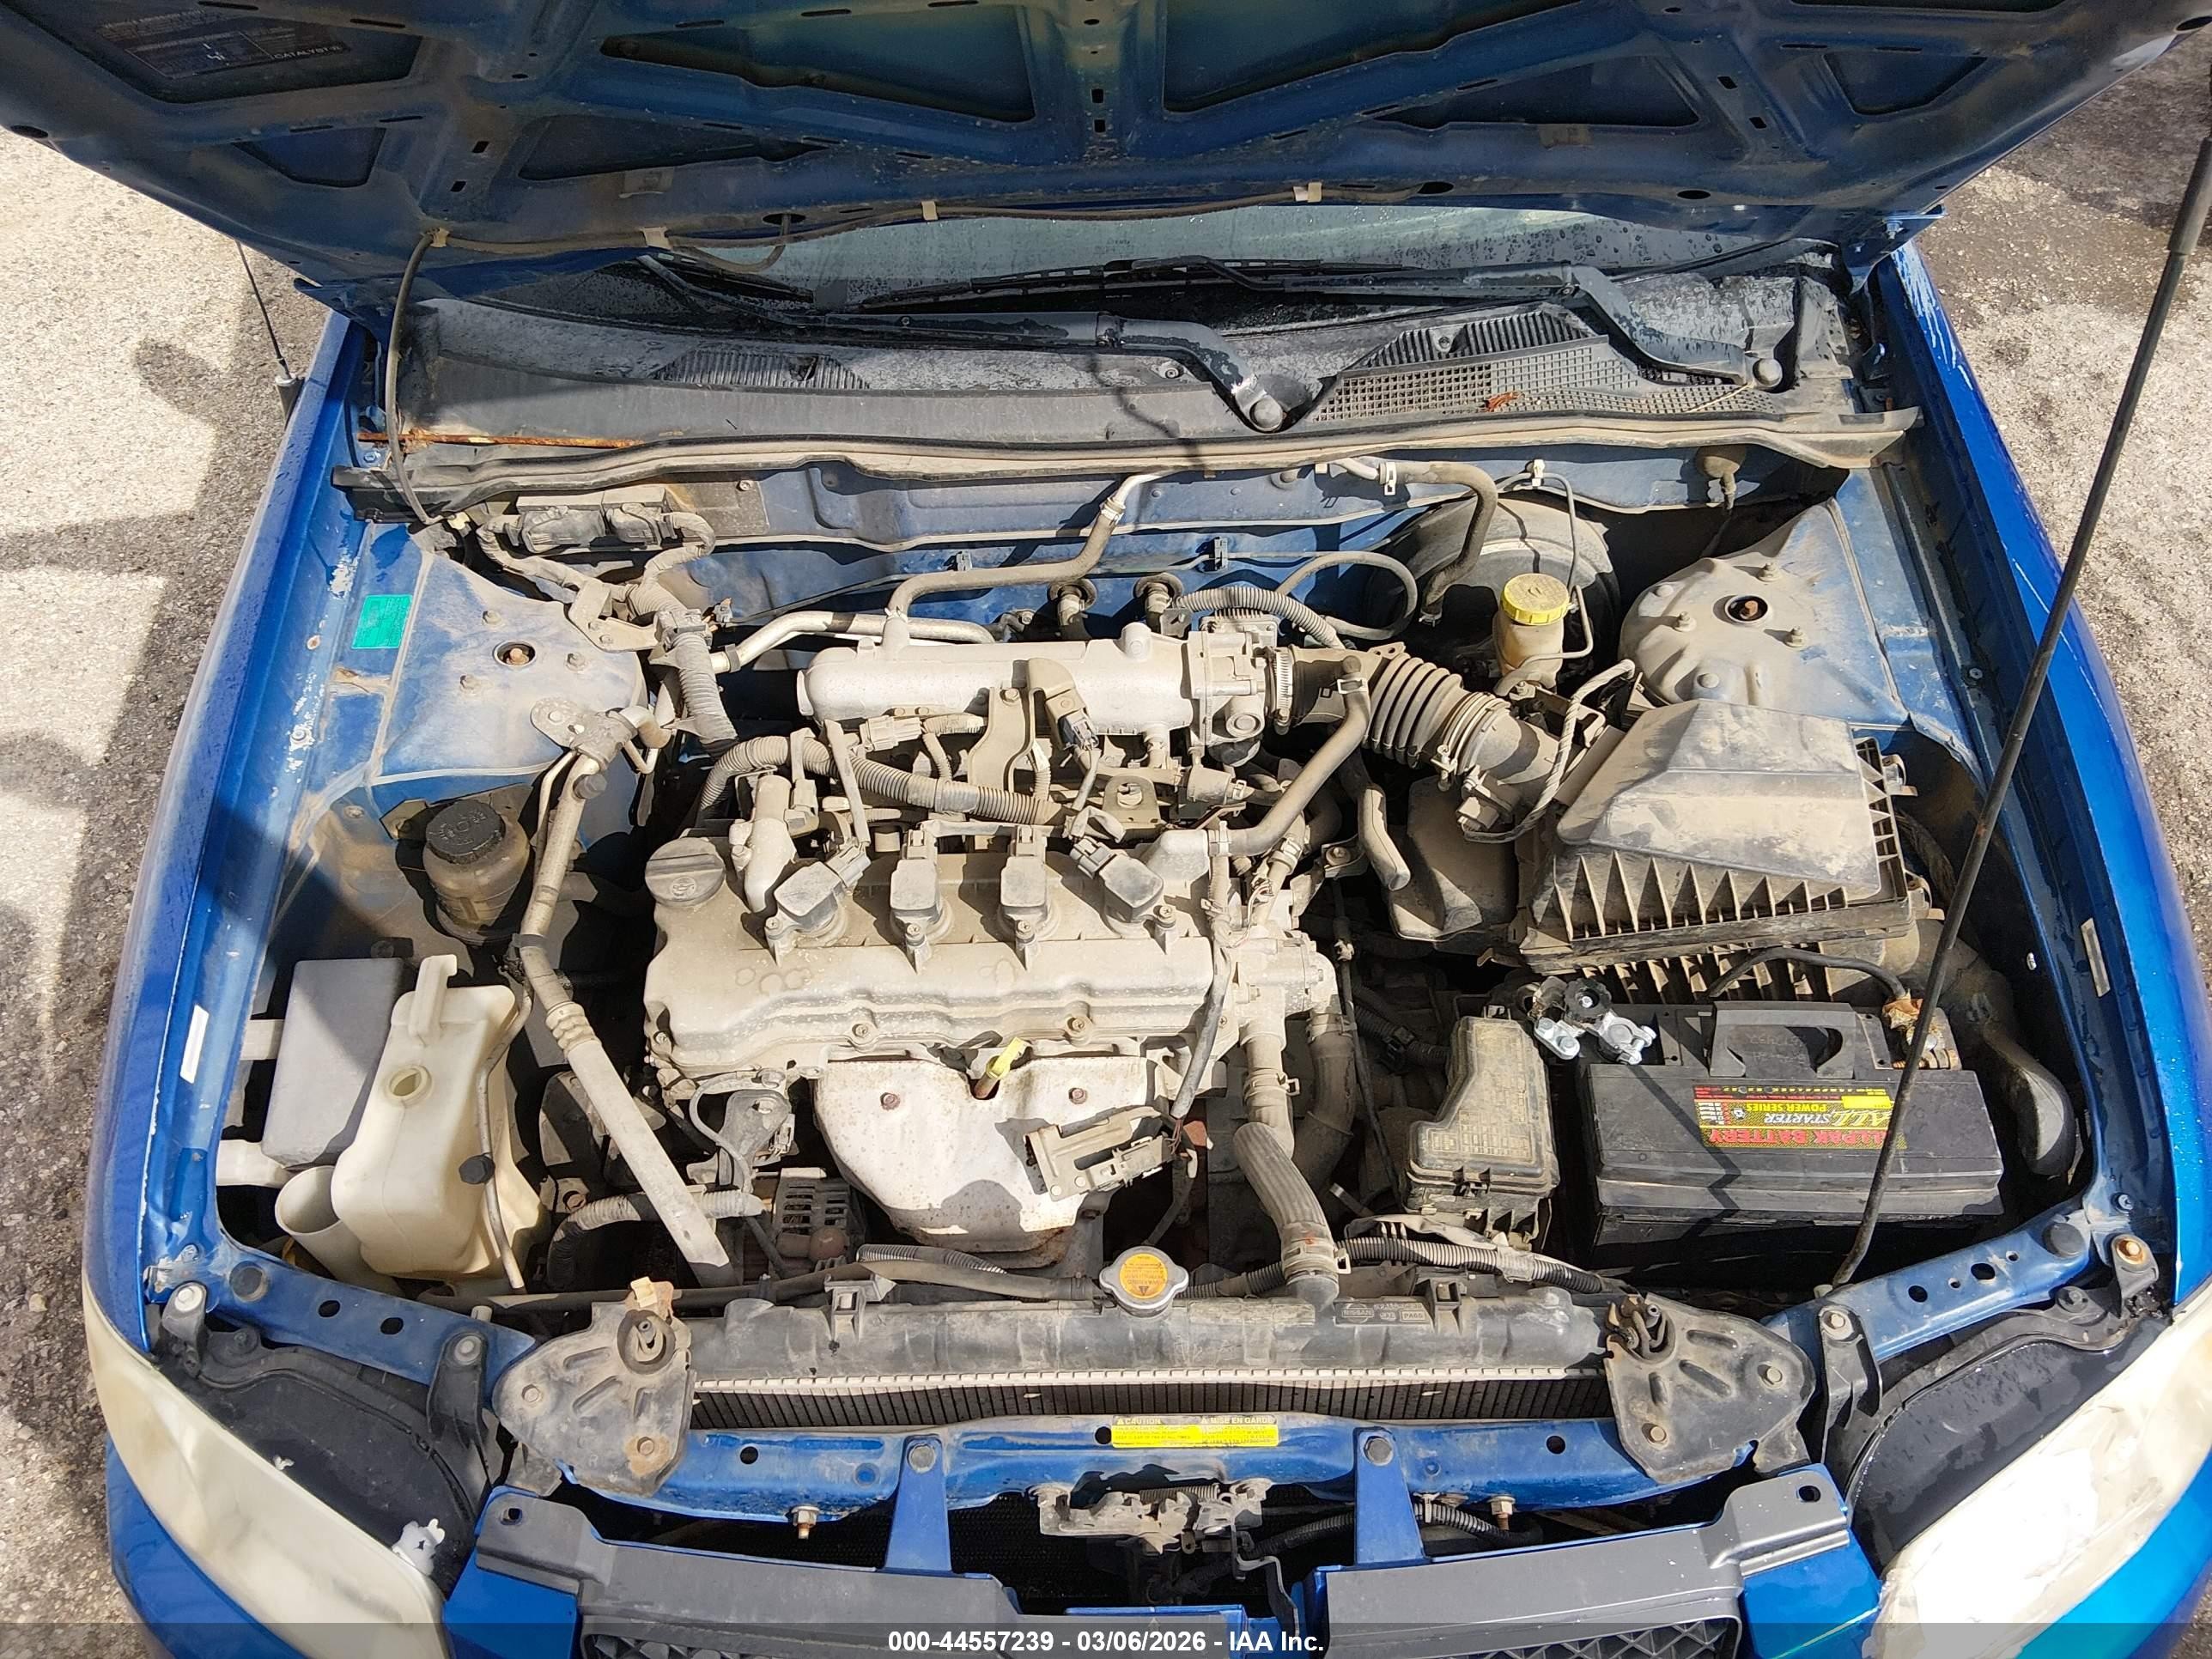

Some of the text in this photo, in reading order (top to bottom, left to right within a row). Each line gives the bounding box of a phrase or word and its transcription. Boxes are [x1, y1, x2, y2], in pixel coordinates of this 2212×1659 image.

[1746, 1103, 1827, 1112] POWER SERIES
[1764, 1109, 1892, 1127] ALL STARTER
[1709, 1128, 1887, 1145] LLPAK BATTERY
